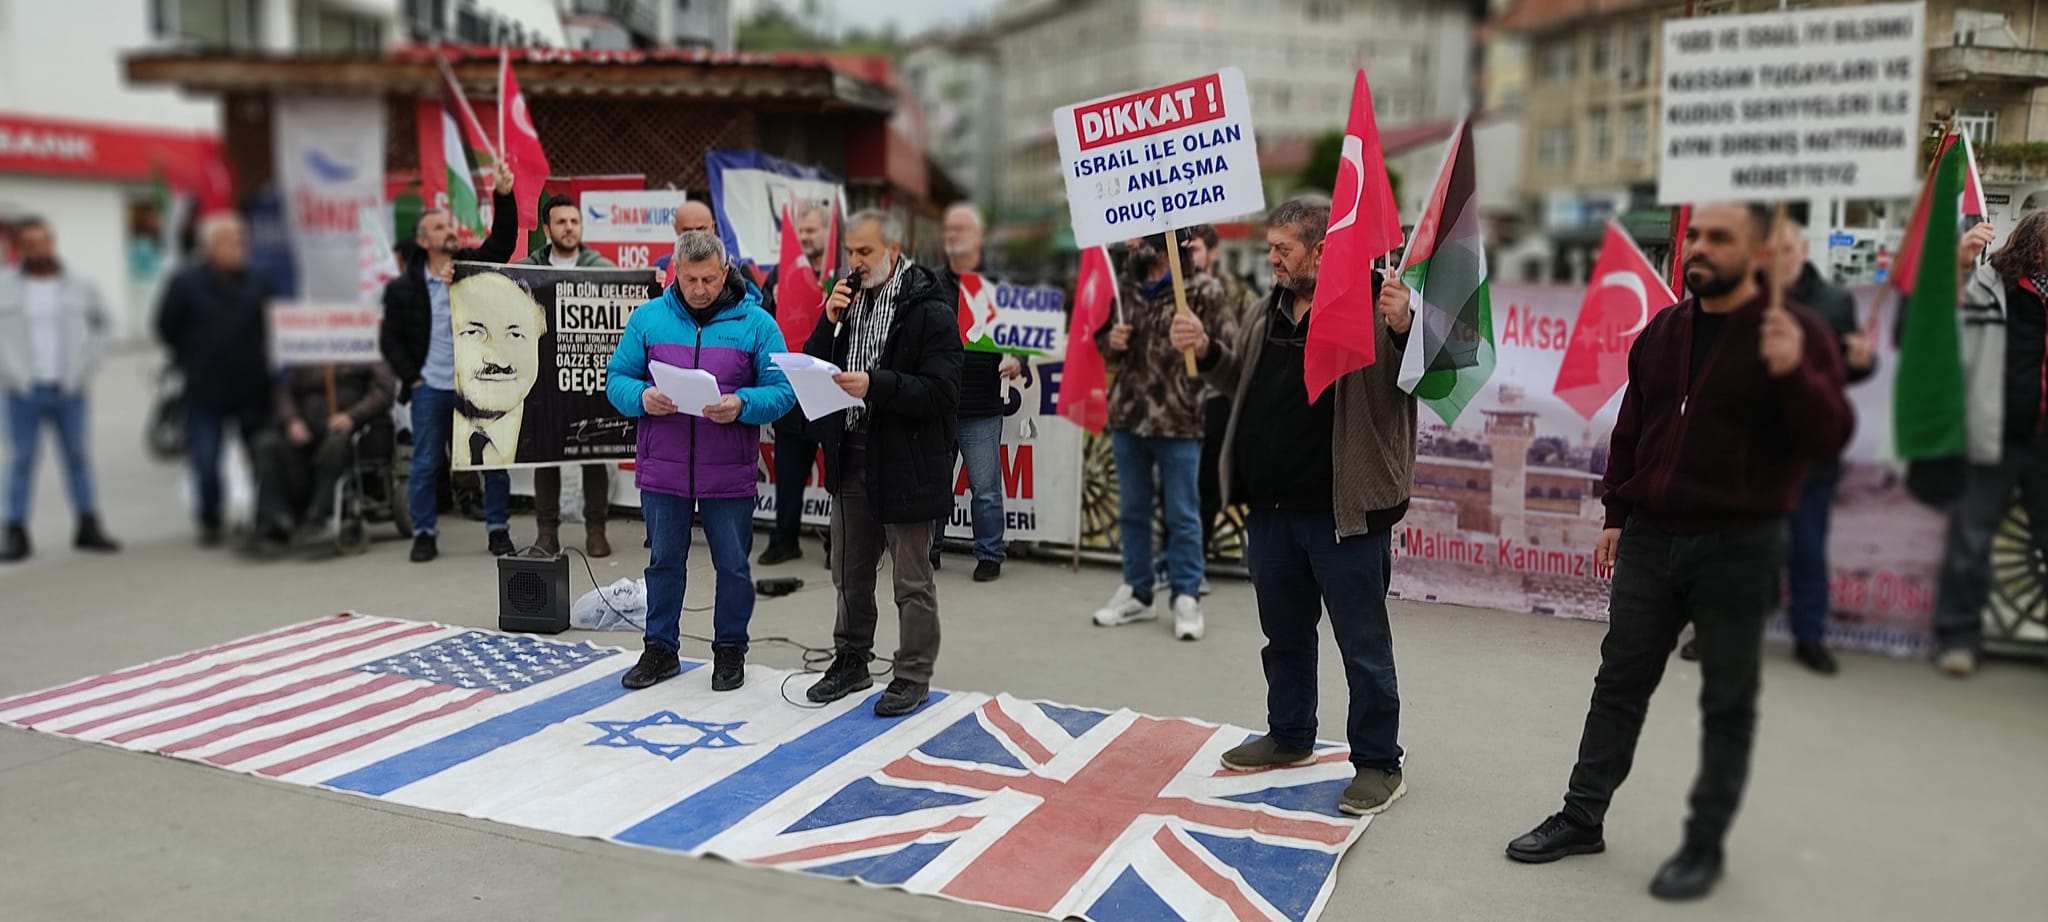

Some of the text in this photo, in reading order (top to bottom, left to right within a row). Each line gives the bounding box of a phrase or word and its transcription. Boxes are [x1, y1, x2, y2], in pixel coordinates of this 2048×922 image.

[1081, 82, 1218, 144] DİKKAT !
[1073, 123, 1242, 178] İSRAİL İLE OLAN
[1127, 154, 1229, 192] ANLAŞMA
[1105, 184, 1226, 225] ORUÇ BOZAR
[994, 324, 1056, 350] GAZZE
[1502, 303, 1568, 351] Aksa
[556, 353, 590, 367] GAZZE
[1498, 538, 1585, 577] Kanımız
